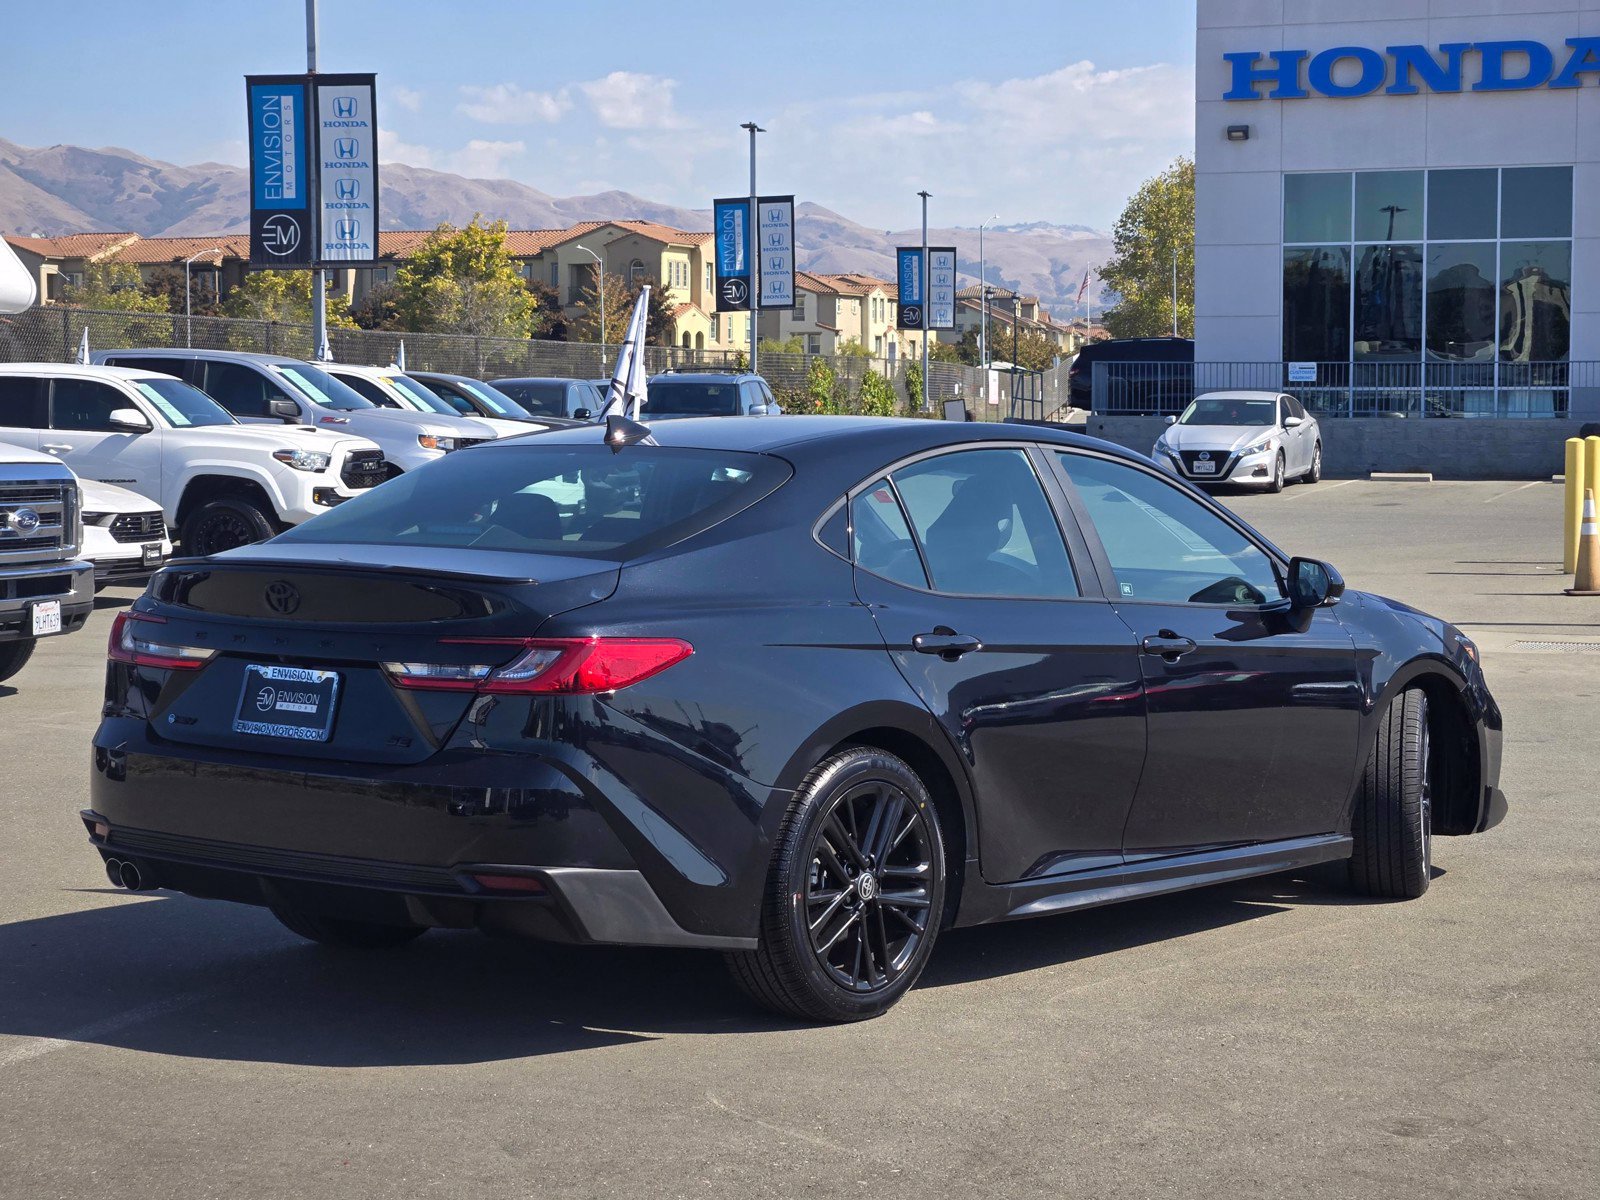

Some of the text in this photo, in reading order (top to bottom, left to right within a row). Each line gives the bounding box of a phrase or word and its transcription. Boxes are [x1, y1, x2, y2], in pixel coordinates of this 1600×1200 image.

[262, 95, 281, 200] ENVISION
[284, 105, 293, 190] MOTORS
[324, 161, 369, 169] HONDA
[723, 209, 734, 271] ENVISION
[904, 255, 913, 301] ENVISION
[35, 613, 59, 630] 9LHT639
[271, 668, 314, 680] ENVISION
[276, 690, 321, 705] ENVISION
[237, 723, 324, 740] ENVISIONMOTORS.COM
